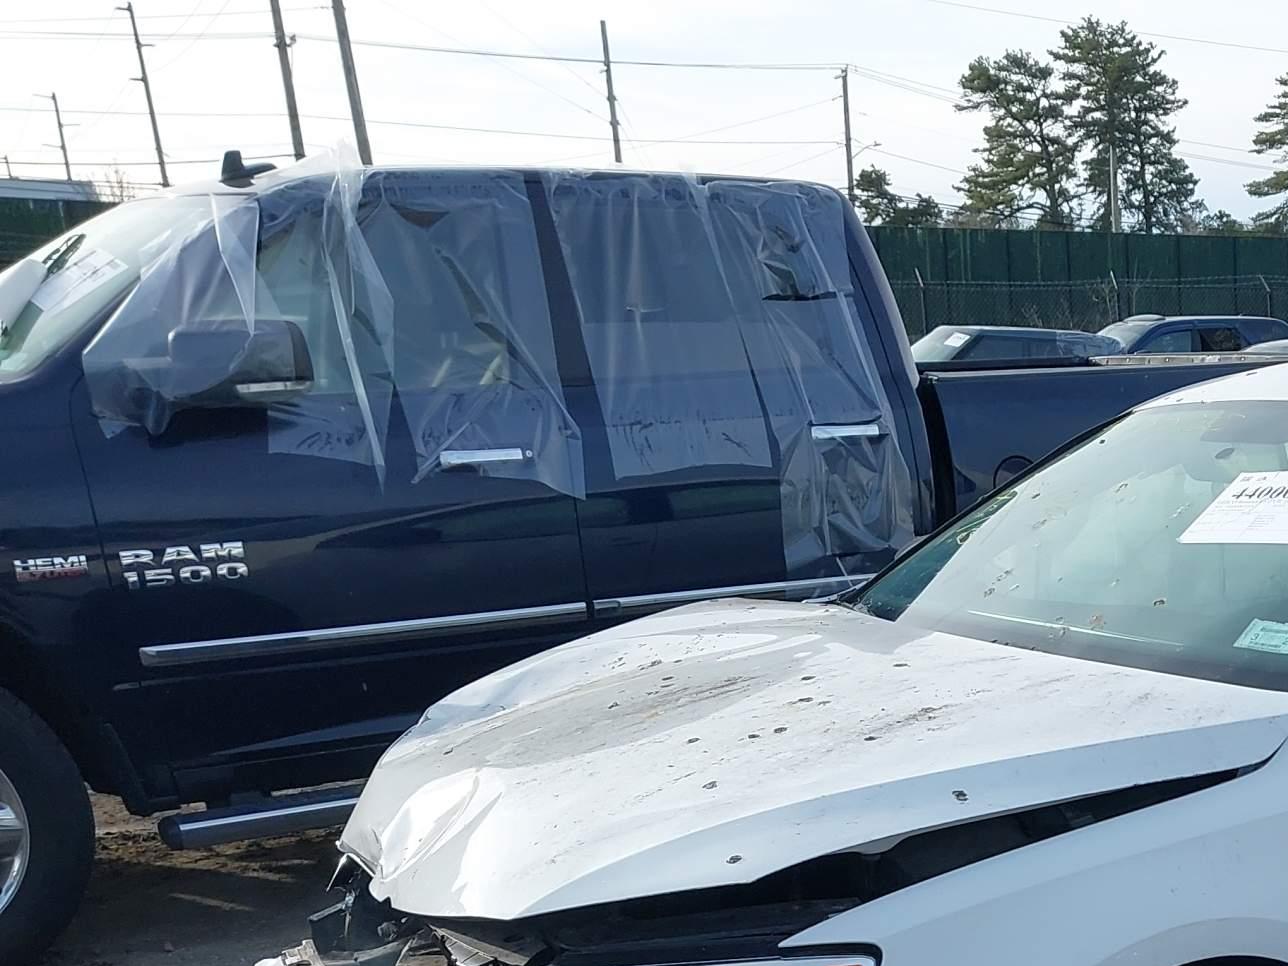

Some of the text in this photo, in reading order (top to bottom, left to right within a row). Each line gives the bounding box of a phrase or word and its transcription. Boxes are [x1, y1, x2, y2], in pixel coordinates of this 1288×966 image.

[13, 554, 88, 573] HEMI
[118, 541, 245, 567] RAM
[123, 562, 249, 590] 1500
